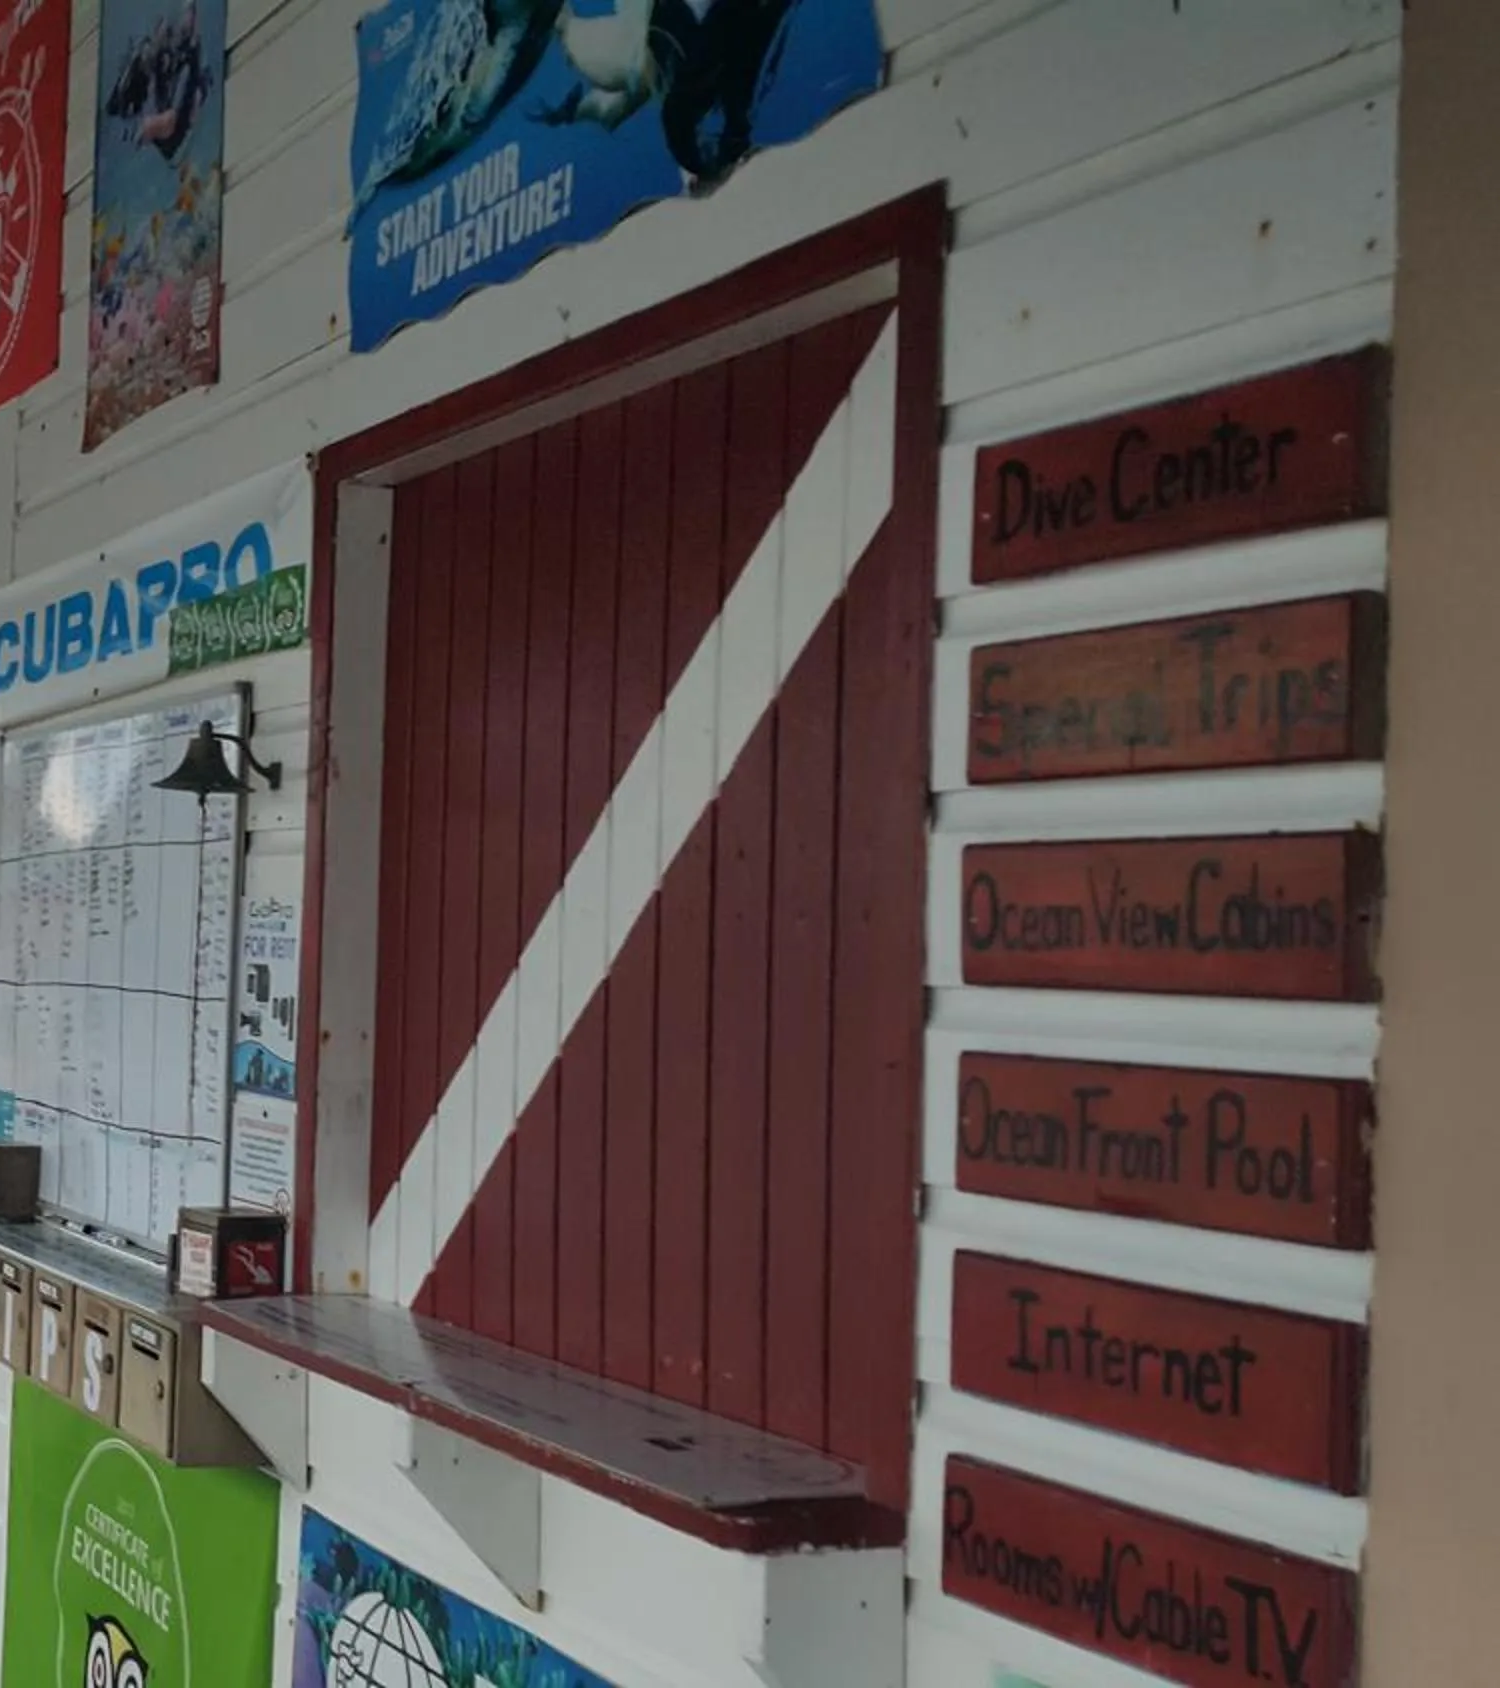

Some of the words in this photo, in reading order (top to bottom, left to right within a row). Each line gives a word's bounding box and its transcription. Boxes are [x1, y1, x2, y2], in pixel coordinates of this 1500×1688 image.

[376, 184, 446, 266] START
[452, 143, 520, 218] YOUR
[410, 163, 574, 296] ADVENTURE!
[992, 457, 1097, 545] Dive
[1108, 412, 1295, 524] Center
[965, 872, 1087, 953] Ocean
[957, 1077, 1069, 1168] Ocean
[1072, 1086, 1190, 1183] Front
[1206, 1091, 1315, 1203] Pool
[1008, 1289, 1256, 1416] Internet
[71, 1525, 172, 1632] EXCELLENCE
[944, 1484, 1064, 1606] Rooms
